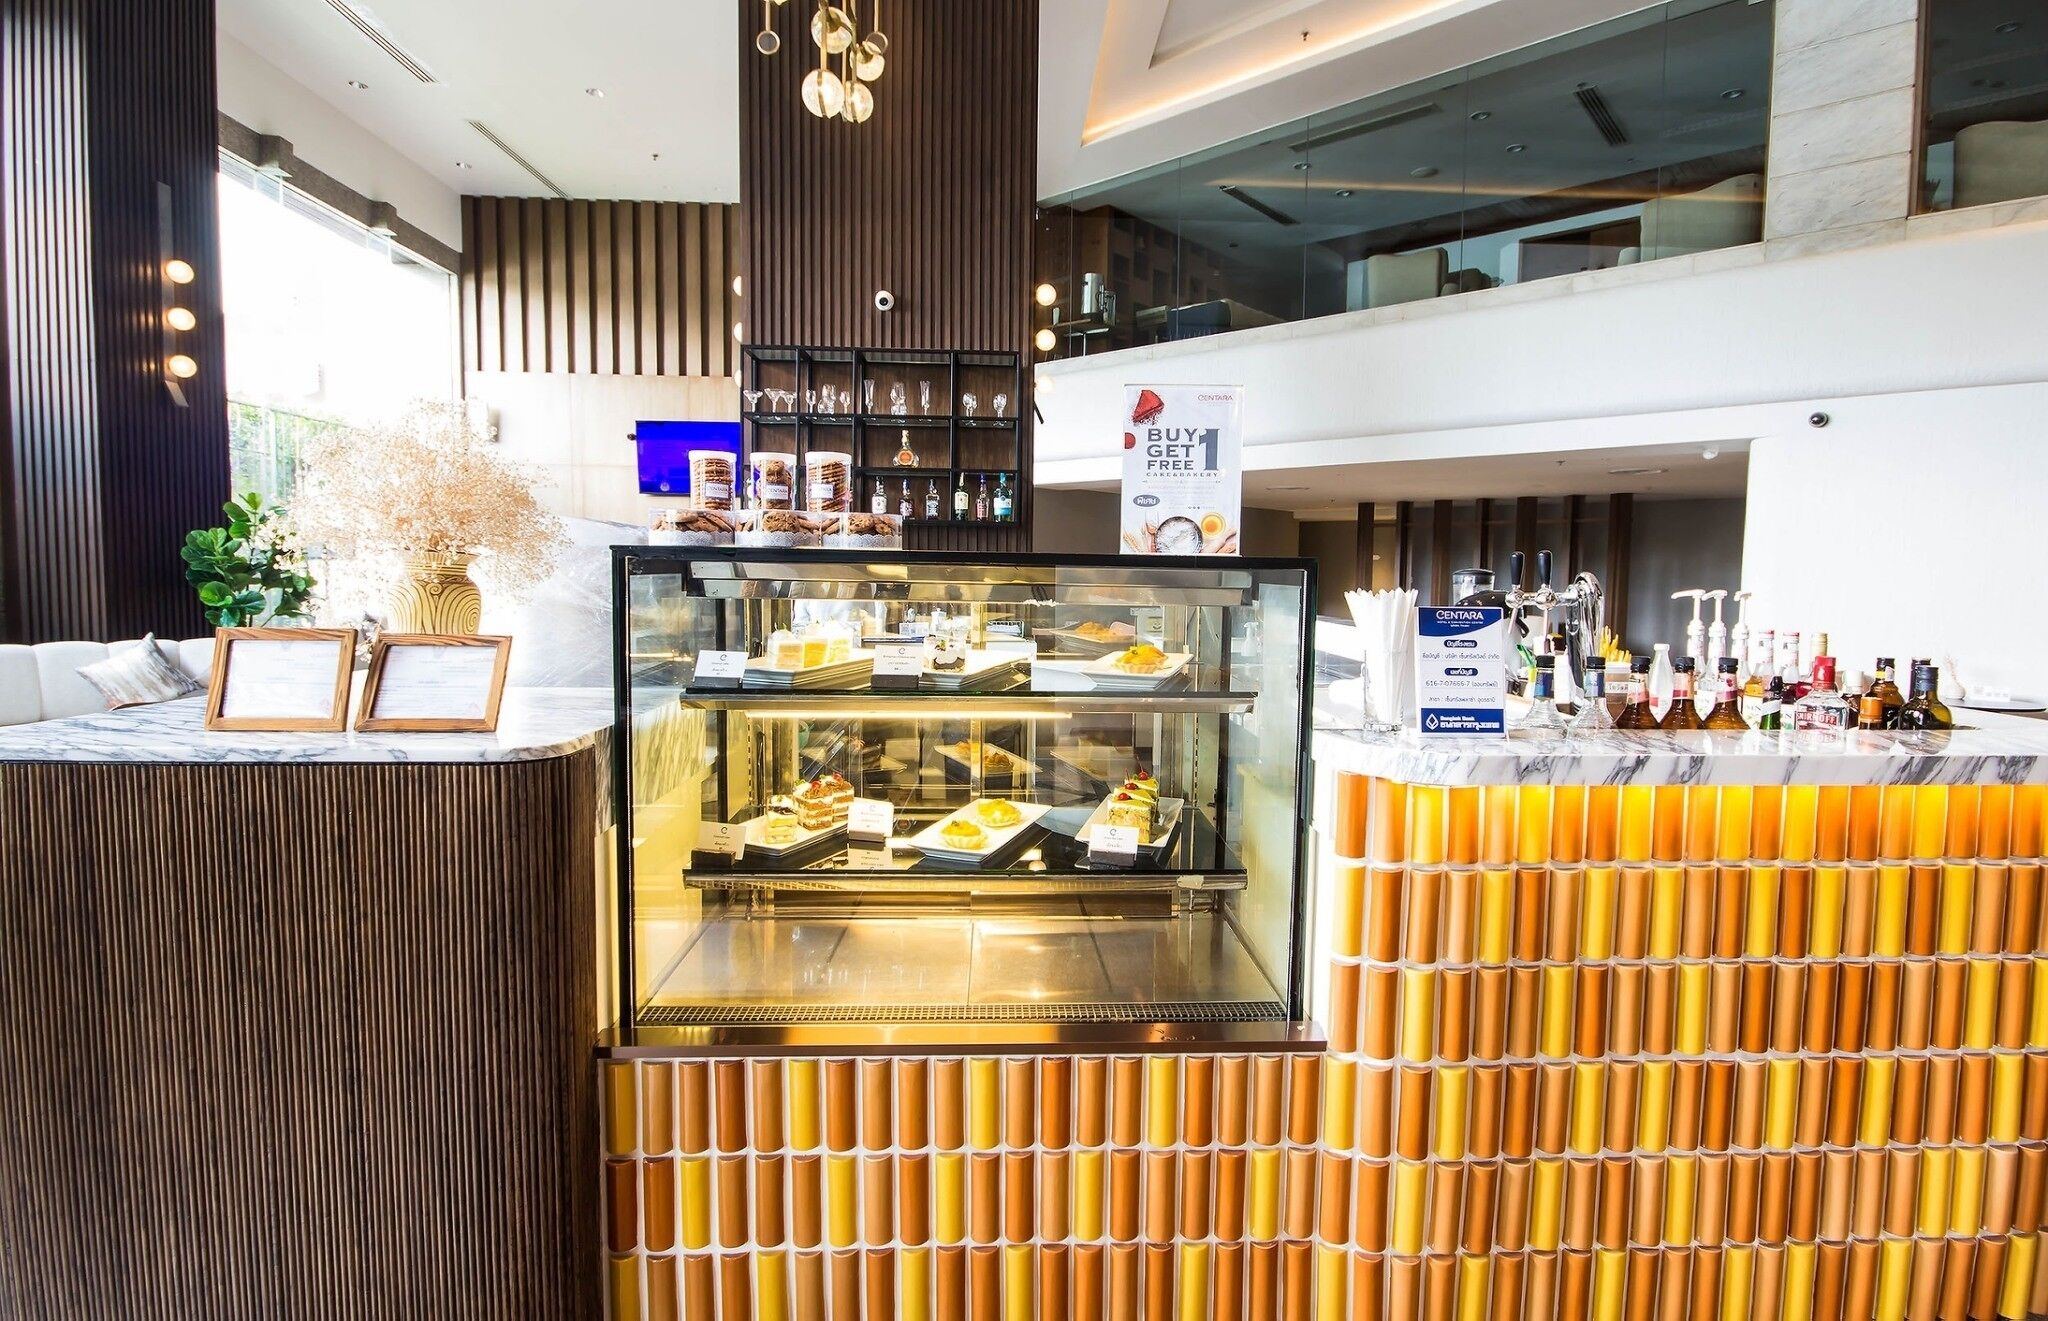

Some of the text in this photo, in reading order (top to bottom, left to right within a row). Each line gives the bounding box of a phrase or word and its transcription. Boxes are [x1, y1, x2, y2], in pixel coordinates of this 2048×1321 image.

[1146, 444, 1195, 458] GET
[1147, 428, 1220, 471] BUY 1
[1147, 460, 1194, 470] FREE
[1436, 610, 1485, 620] CENTARA
